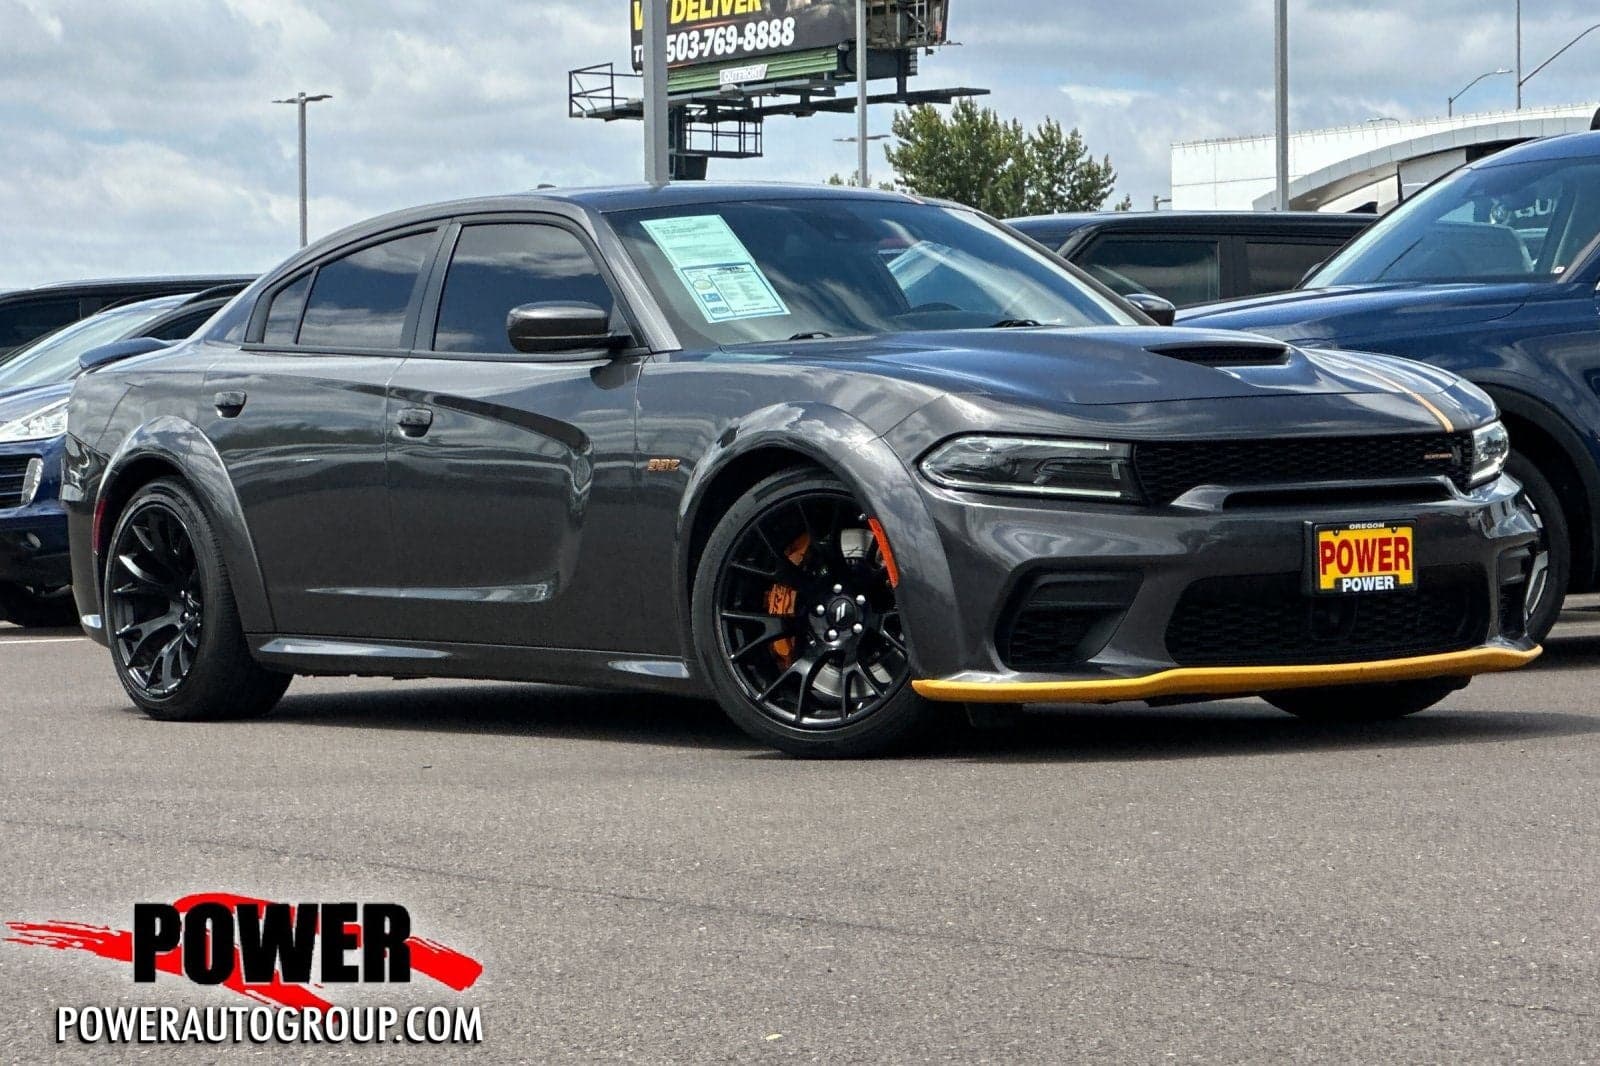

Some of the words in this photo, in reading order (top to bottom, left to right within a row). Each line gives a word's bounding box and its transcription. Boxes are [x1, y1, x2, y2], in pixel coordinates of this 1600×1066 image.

[666, 17, 796, 63] 503-769-8888
[1349, 522, 1385, 530] OREGON
[1320, 536, 1411, 576] POWER
[1342, 575, 1395, 593] POWER
